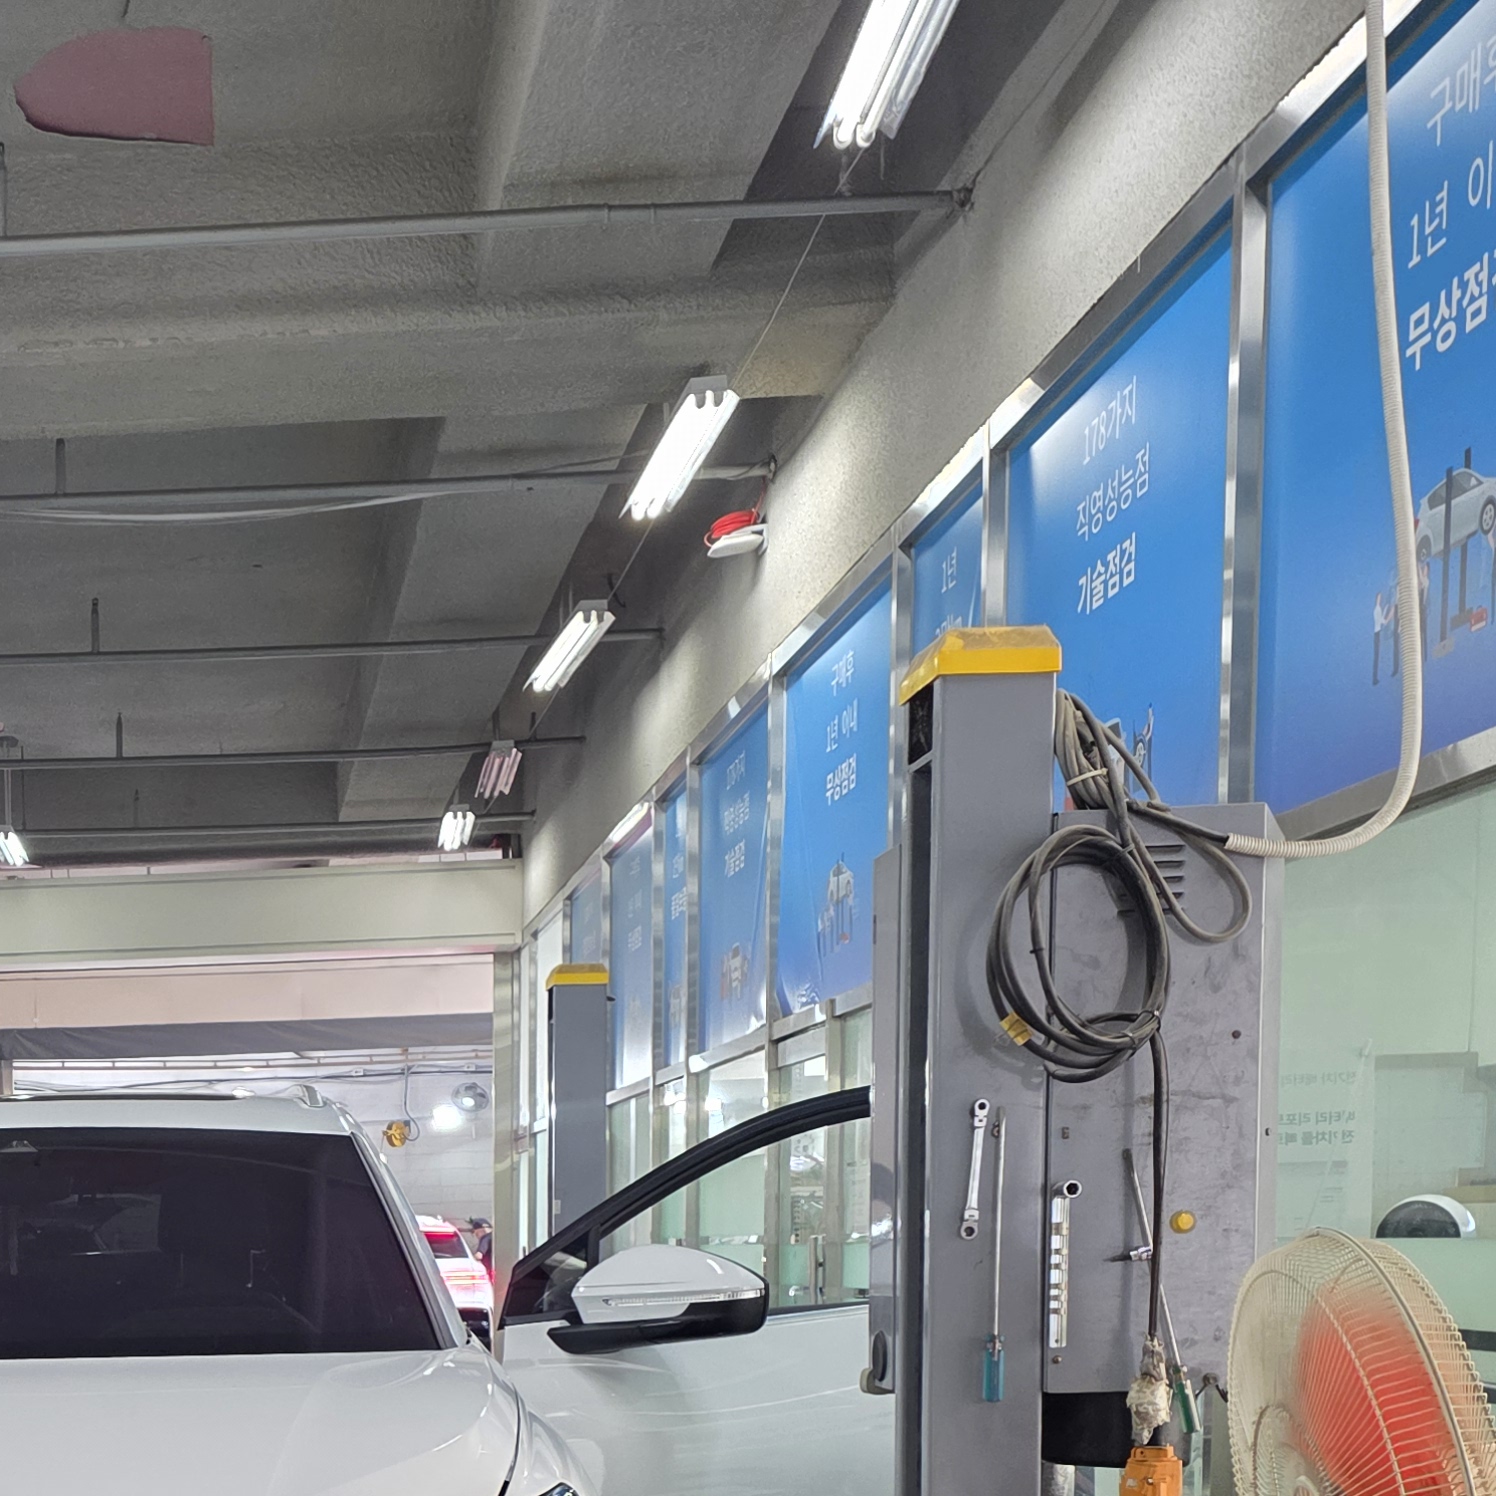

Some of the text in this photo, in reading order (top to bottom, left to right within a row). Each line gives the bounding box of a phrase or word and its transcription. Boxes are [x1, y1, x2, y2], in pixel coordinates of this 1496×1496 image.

[1407, 179, 1450, 269] 1년
[1406, 250, 1496, 371] 무상점
[1083, 375, 1137, 466] 178가지
[1076, 441, 1150, 542] 직영성능점
[941, 546, 957, 594] 1년
[1077, 531, 1137, 616] 기술점검
[831, 650, 855, 697] 구매후
[826, 697, 858, 753] 1년 이내
[825, 752, 857, 806] 무상점검
